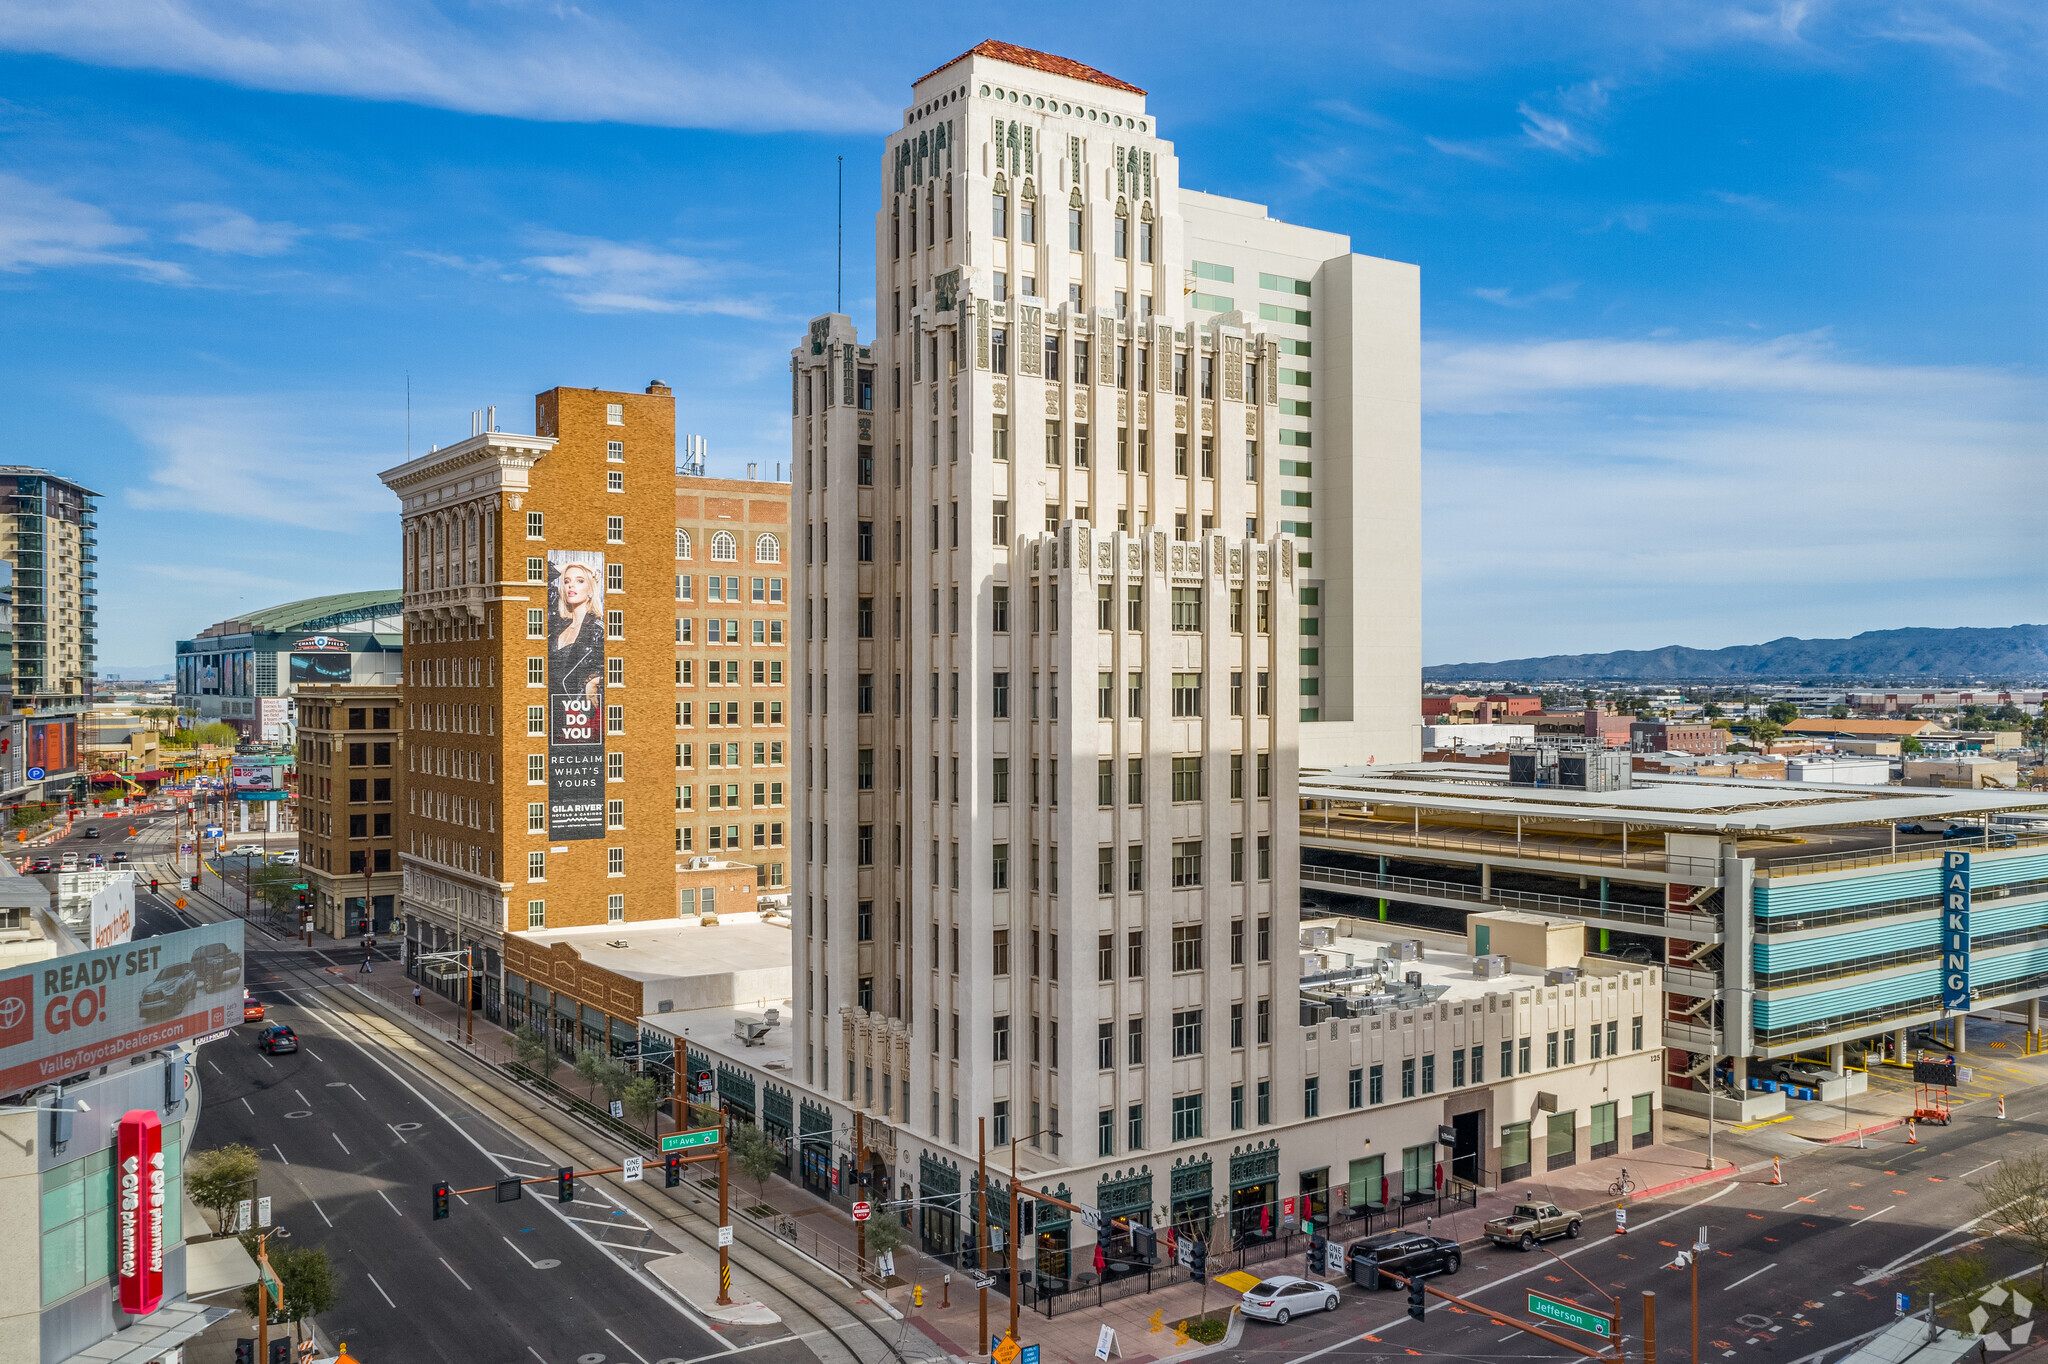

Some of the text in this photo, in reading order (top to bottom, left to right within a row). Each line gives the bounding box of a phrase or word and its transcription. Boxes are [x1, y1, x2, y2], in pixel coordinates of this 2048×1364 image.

[562, 700, 591, 711] YOU
[566, 714, 587, 725] DO
[562, 728, 591, 739] YOU
[552, 756, 602, 764] RECLAIM
[555, 768, 599, 776] WHAT'S
[1947, 853, 1965, 990] PARKING
[96, 924, 113, 949] Happy
[44, 945, 162, 996] READY SET
[44, 984, 107, 1035] GO!
[40, 1024, 184, 1076] ValleyToyotaDealers.com
[680, 1138, 696, 1146] Ave.
[122, 1174, 138, 1211] CVS
[151, 1169, 165, 1207] CVS
[120, 1210, 136, 1278] pharmacy
[150, 1208, 164, 1273] pharmacy
[1180, 1241, 1190, 1251] ONE
[1330, 1244, 1341, 1254] ONE
[1329, 1252, 1342, 1261] WAY
[1536, 1302, 1582, 1324] Jefferson
